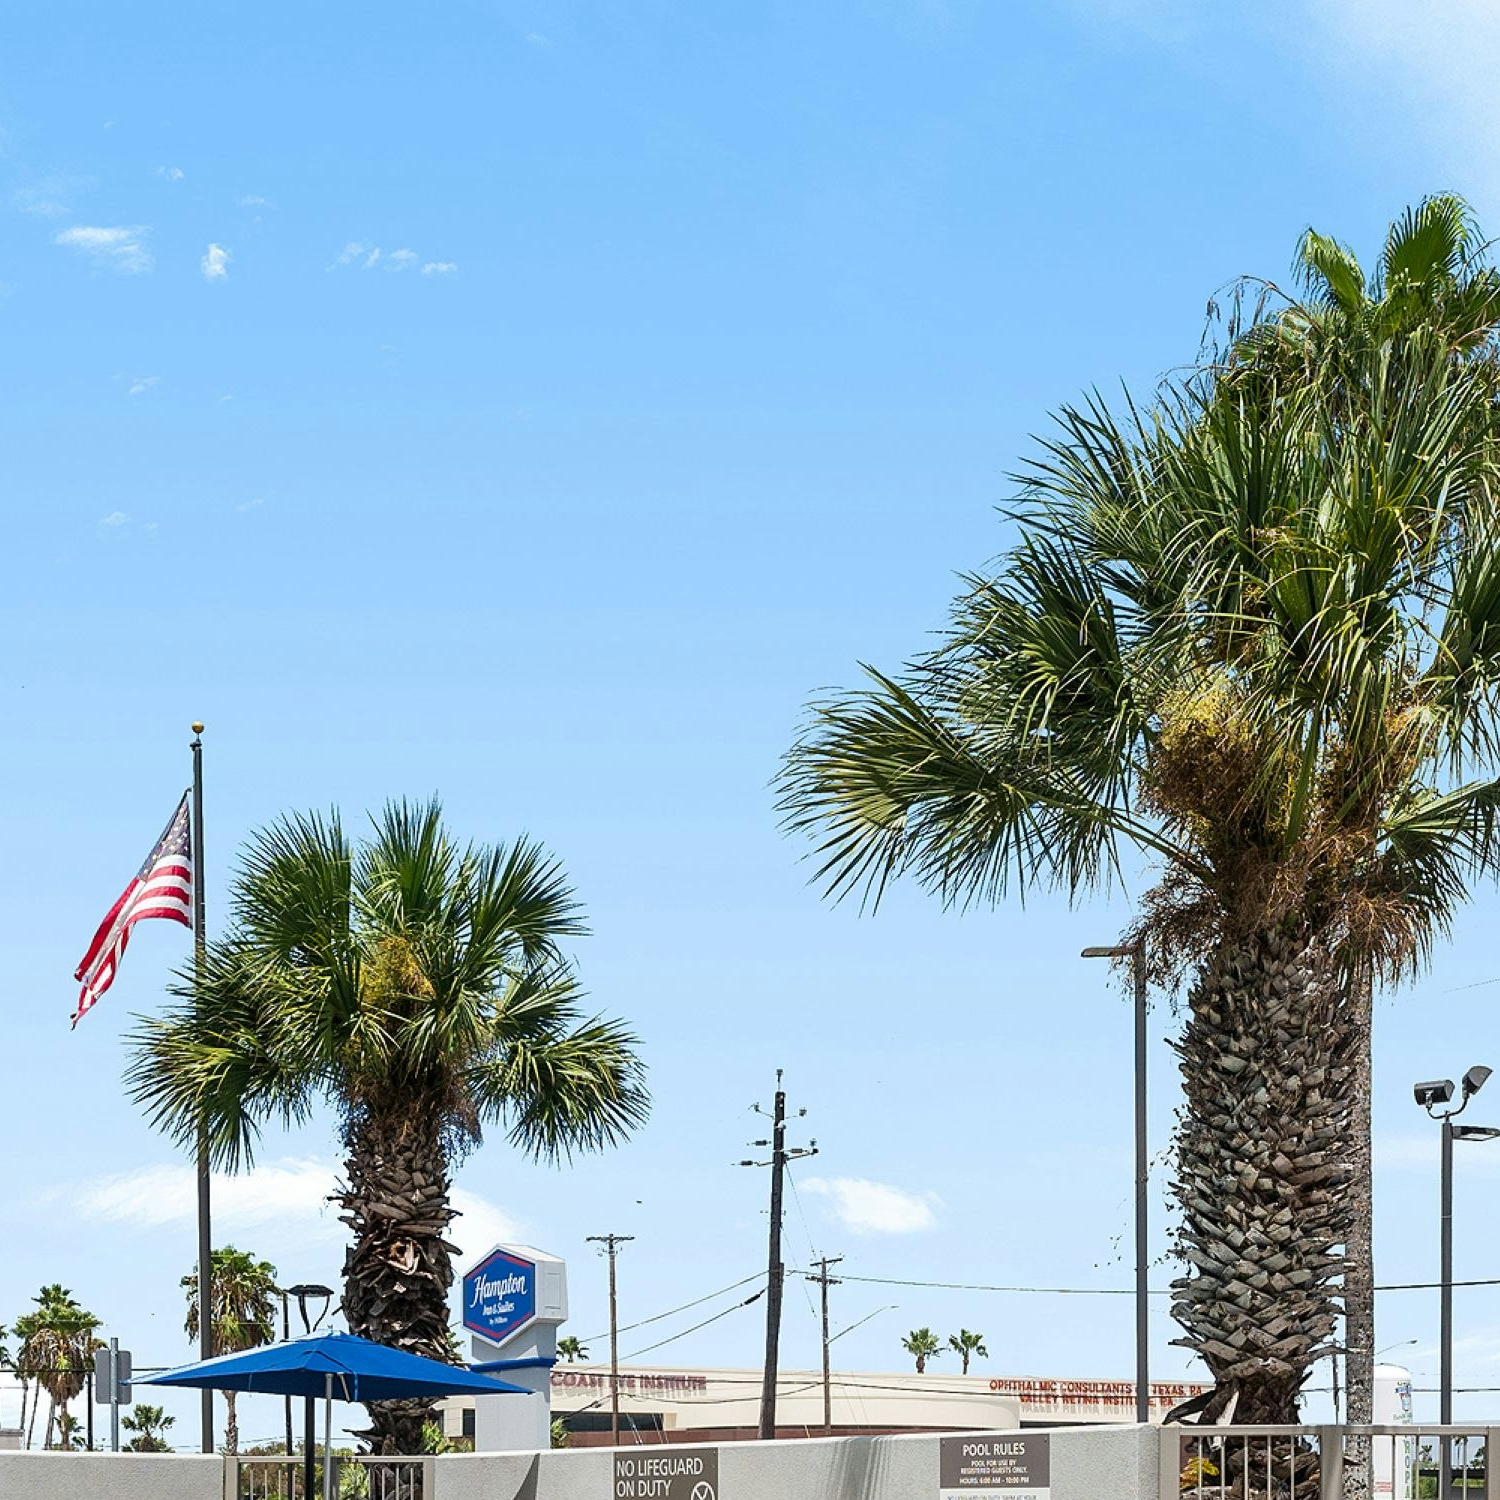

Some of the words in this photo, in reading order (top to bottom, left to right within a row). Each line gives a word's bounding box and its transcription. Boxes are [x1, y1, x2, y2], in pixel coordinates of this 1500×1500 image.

[469, 1273, 528, 1308] Hampton
[498, 1301, 514, 1312] Suites
[550, 1372, 602, 1388] COAST
[640, 1375, 706, 1390] INSTITUTE
[989, 1380, 1057, 1391] OPHTHALMIC
[1060, 1382, 1132, 1394] CONSULTANTS
[1020, 1394, 1058, 1404] VALLEY
[1062, 1395, 1099, 1405] RETINA
[963, 1444, 991, 1456] POOL
[994, 1442, 1025, 1455] RULES
[617, 1460, 634, 1477] NO
[639, 1458, 703, 1476] LIFEGUARD
[617, 1480, 634, 1497] ON
[639, 1480, 672, 1497] DUTY
